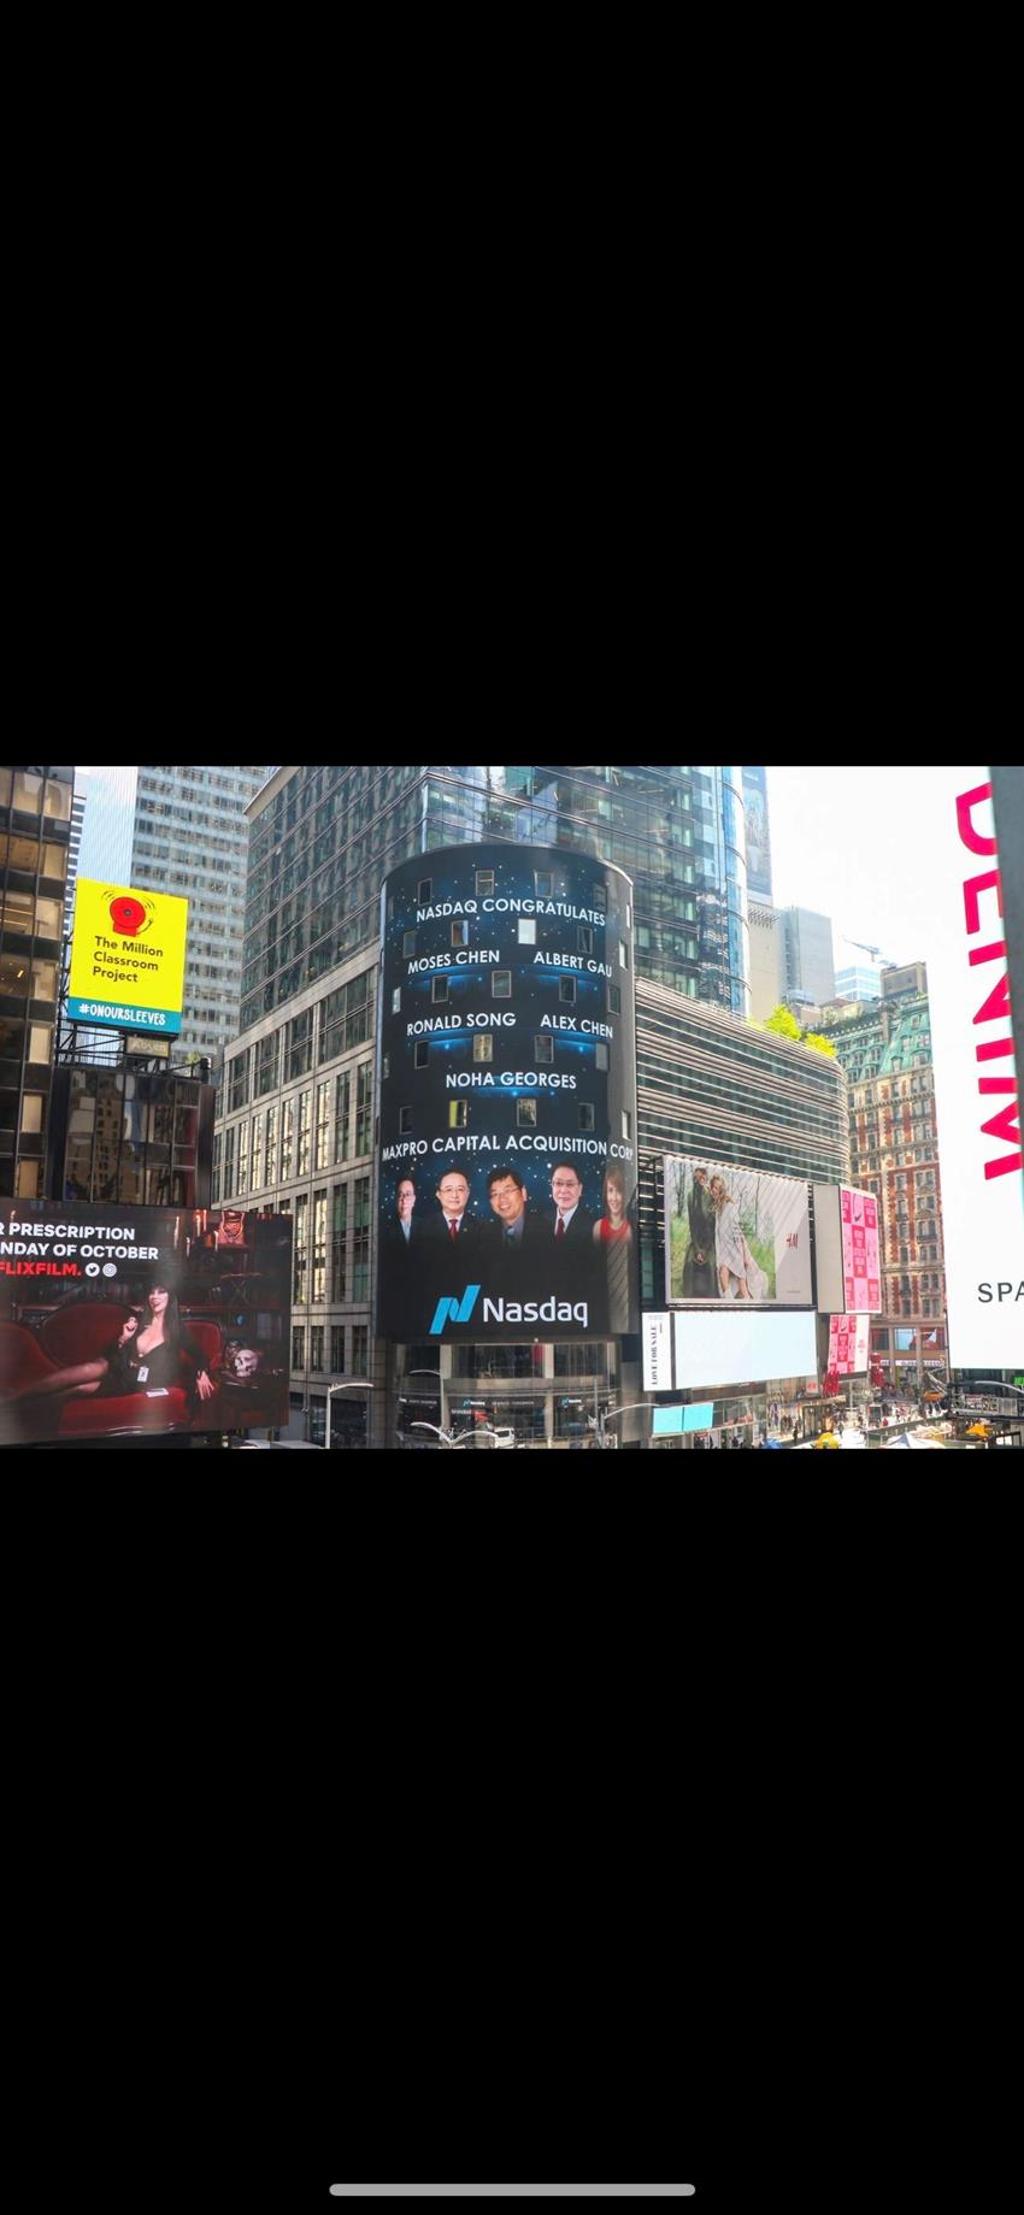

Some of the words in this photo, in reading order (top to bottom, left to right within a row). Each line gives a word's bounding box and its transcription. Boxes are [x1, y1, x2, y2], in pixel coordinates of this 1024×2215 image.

[416, 899, 477, 923] NASDAQ
[482, 899, 606, 927] CONGRATULATES
[94, 935, 118, 950] The
[121, 941, 164, 957] Million
[93, 951, 159, 971] Classroom
[407, 953, 451, 975] MOSES
[455, 950, 500, 965] CHEN
[533, 952, 584, 970] ALBERT
[587, 959, 613, 978] GAU
[92, 966, 138, 983] Project
[78, 1003, 166, 1026] #ONOURSLEEVES
[406, 1015, 462, 1037] RONALD
[466, 1012, 517, 1028] SONG
[540, 1014, 577, 1031] ALEX
[580, 1019, 614, 1039] CHEN
[446, 1072, 496, 1089] NOHA
[500, 1072, 577, 1089] GEORGES
[382, 1139, 428, 1161] MAXPRO
[431, 1135, 501, 1153] CAPITAL
[505, 1135, 607, 1156] ACQUISITION
[9, 1223, 135, 1240] PRESCRIPTION
[0, 1241, 50, 1256] NDAY
[53, 1244, 77, 1257] OF
[80, 1245, 159, 1260] OCTOBER
[482, 1296, 588, 1329] Nasdaq
